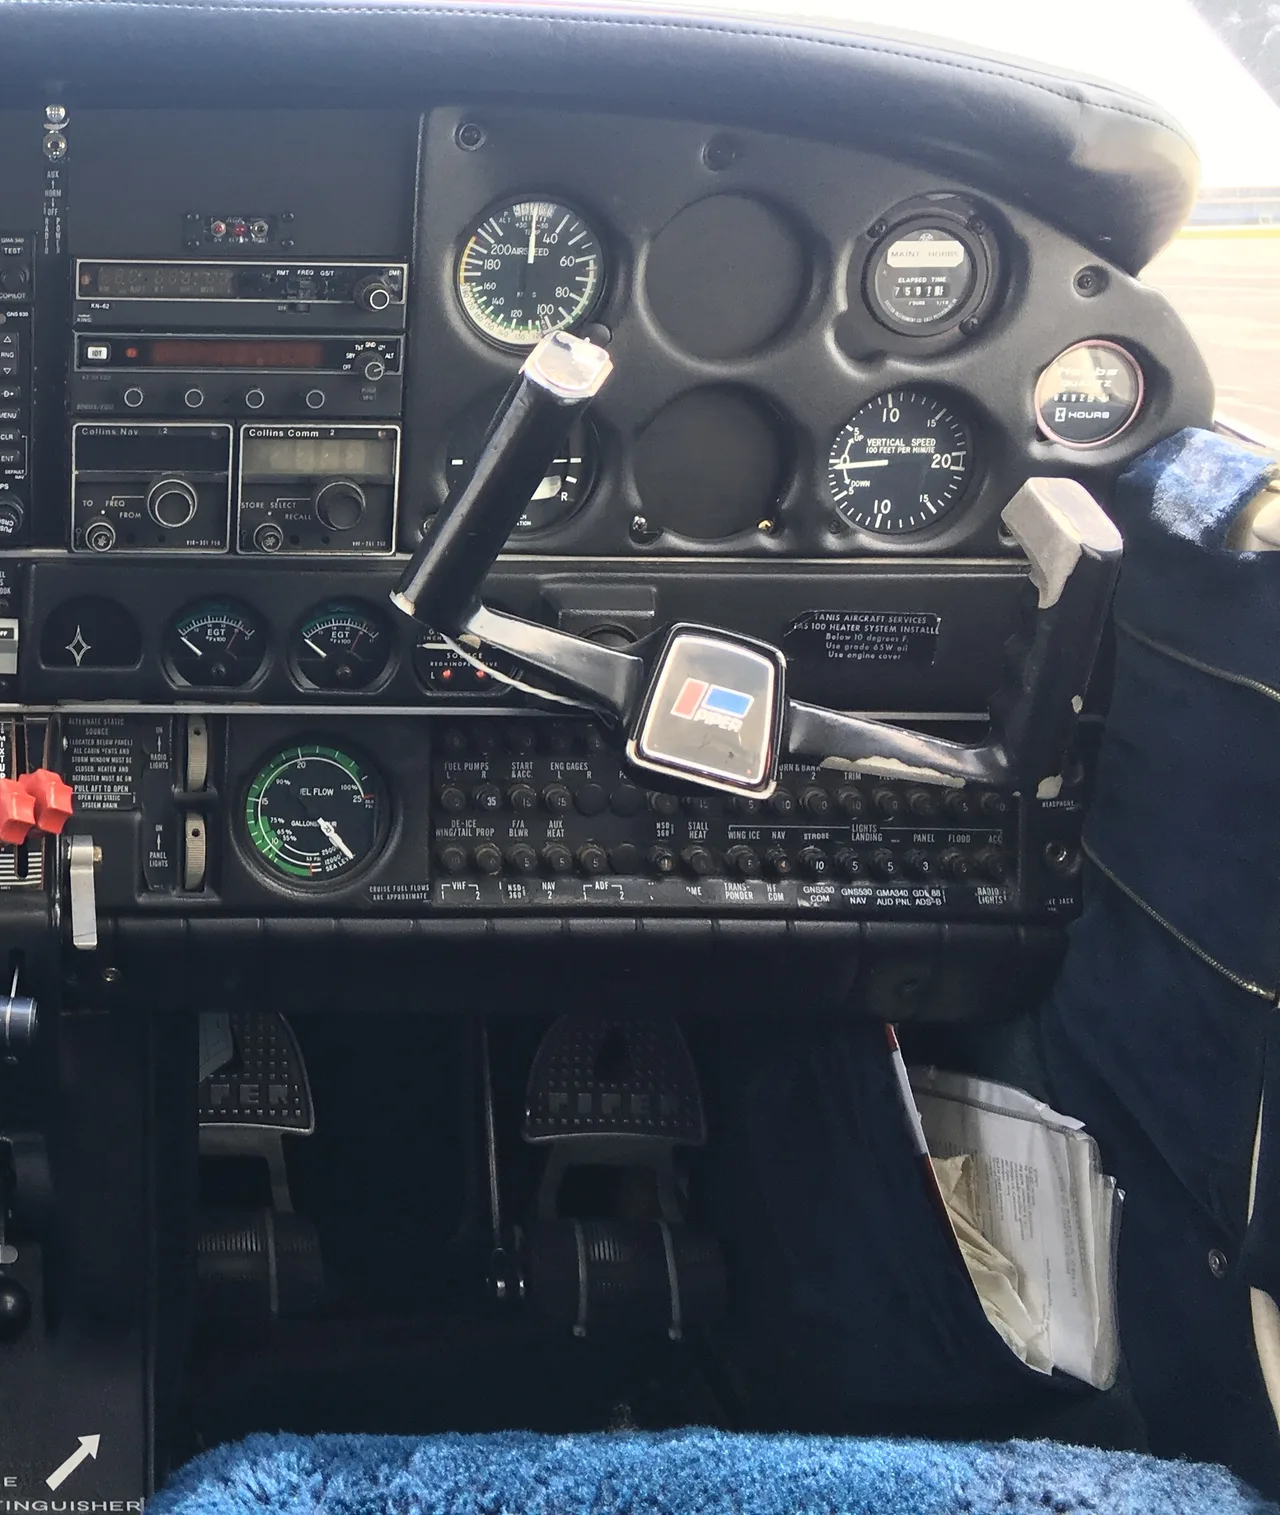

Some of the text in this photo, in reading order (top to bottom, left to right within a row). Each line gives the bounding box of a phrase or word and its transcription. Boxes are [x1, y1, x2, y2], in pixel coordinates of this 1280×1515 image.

[542, 233, 558, 244] 40
[559, 256, 576, 267] 60
[555, 287, 570, 298] 80
[536, 304, 554, 315] 100
[882, 408, 900, 422] 10
[81, 427, 118, 436] Collins
[249, 429, 285, 438] Collins
[287, 430, 319, 438] Comm
[866, 438, 936, 447] VERTICAL SPEED
[930, 453, 952, 469] 20
[241, 502, 297, 510] STORE SELECT
[284, 513, 312, 521] RECALL
[844, 614, 927, 624] AIRCRAFT SERVICES
[830, 624, 860, 632] HEATER
[332, 631, 350, 639] EGT
[847, 652, 876, 661] engine
[296, 761, 306, 769] 20
[444, 762, 490, 772] FUEL PUMPS
[511, 762, 534, 770] START
[550, 762, 589, 772] ENG GAGES
[74, 784, 129, 792] PULL AFT TO OPEN
[312, 787, 334, 796] FLOW
[352, 795, 362, 804] 25
[548, 820, 564, 828] AUX
[852, 824, 878, 833] LIGHTS
[546, 828, 565, 838] HEAT
[852, 832, 883, 842] LANDING
[913, 834, 936, 843] PANEL
[369, 884, 430, 893] CRUISE FUEL FLOWS
[840, 888, 873, 896] GNS530
[876, 888, 909, 897] GMA340
[372, 892, 428, 901] ARE APPROXIMATE
[850, 896, 868, 905] NAV
[876, 898, 911, 906] AUD PNL
